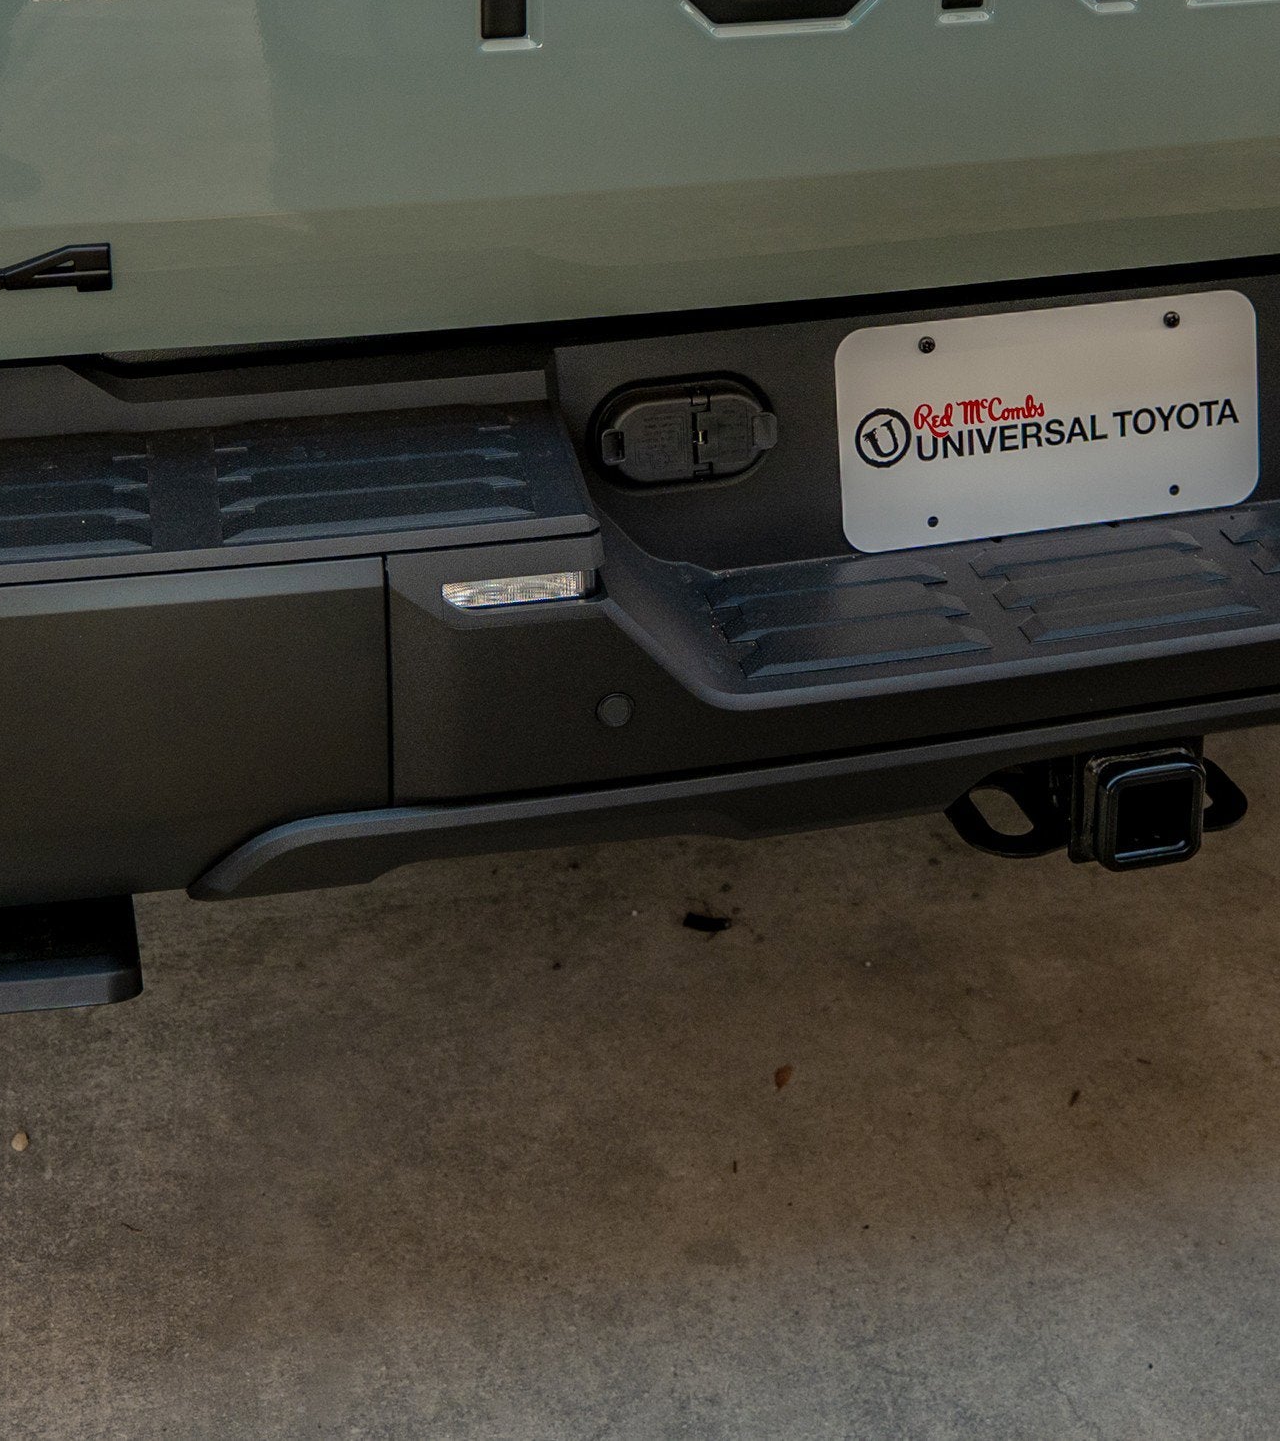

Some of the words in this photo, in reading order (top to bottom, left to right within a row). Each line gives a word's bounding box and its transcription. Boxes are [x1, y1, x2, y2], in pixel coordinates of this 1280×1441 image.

[913, 402, 953, 439] Red
[956, 394, 1045, 426] McCombs
[916, 414, 1108, 462] UNIVERSAL
[1112, 398, 1240, 438] TOYOTA
